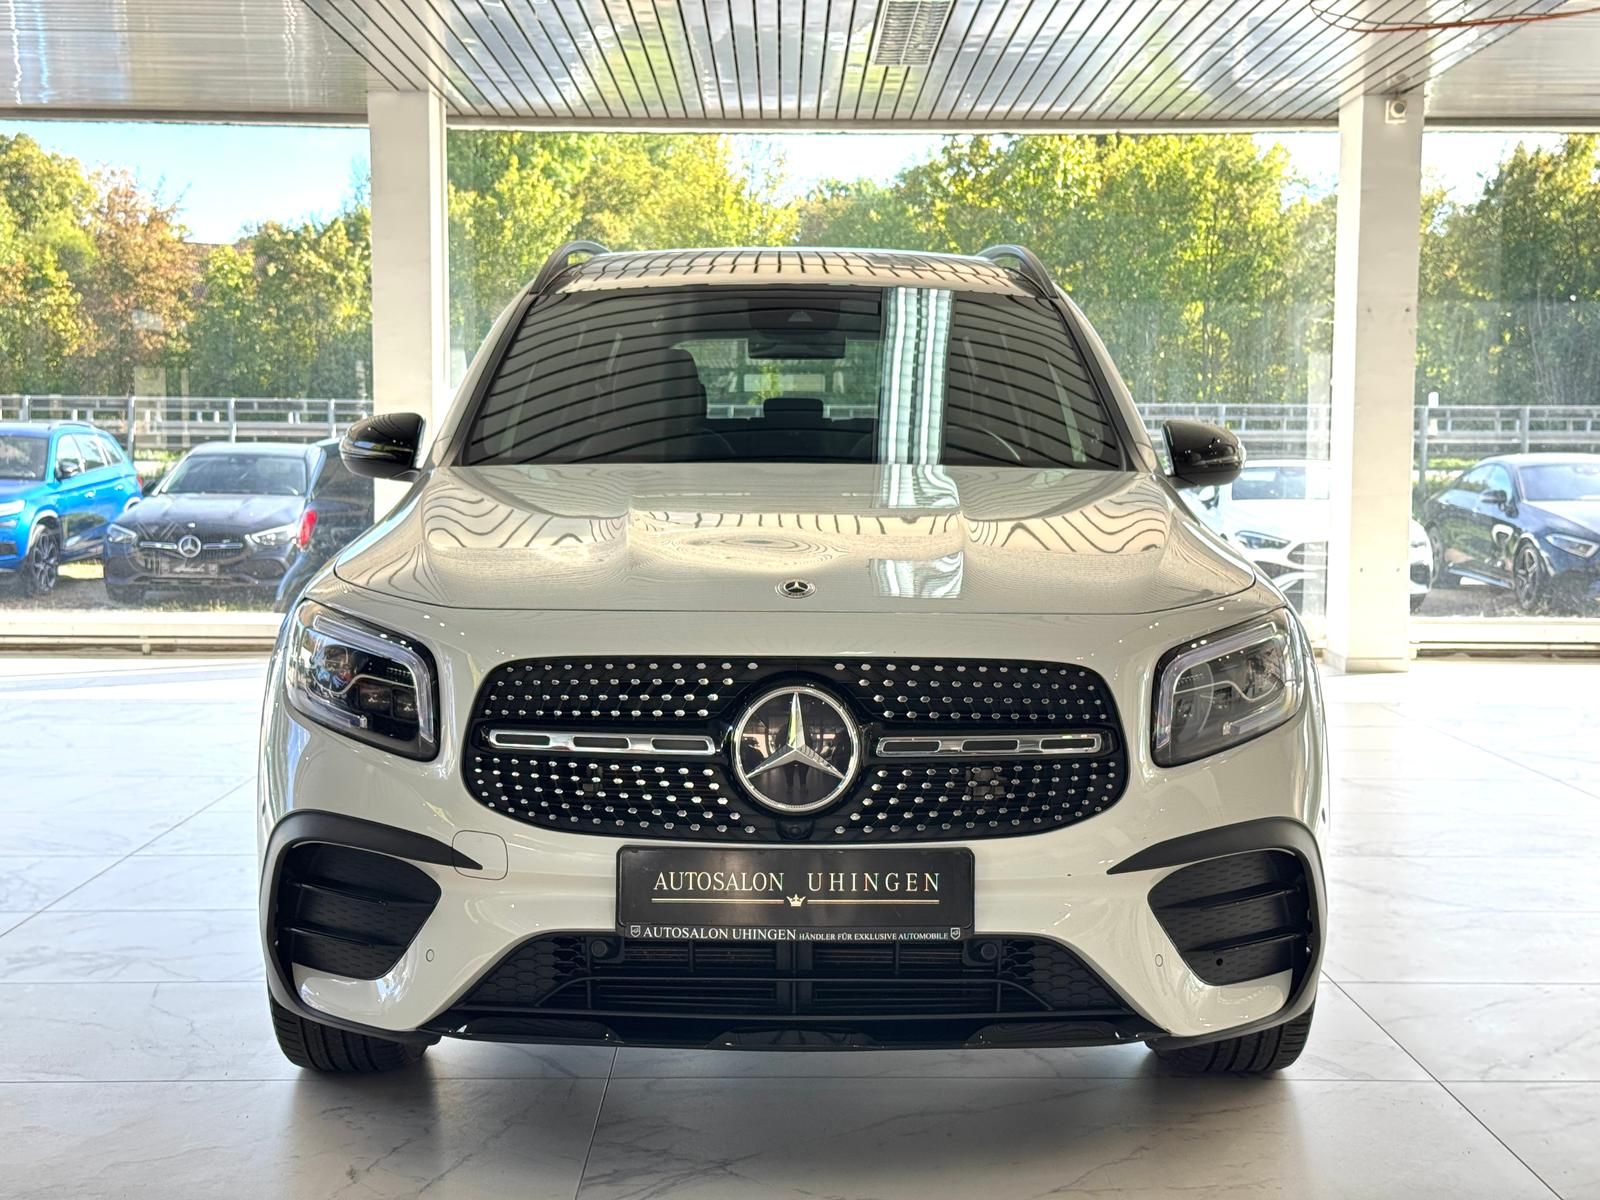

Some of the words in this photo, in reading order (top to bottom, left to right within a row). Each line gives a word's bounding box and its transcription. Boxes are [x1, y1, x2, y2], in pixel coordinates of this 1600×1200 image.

[653, 872, 785, 891] AUTOSALON
[808, 872, 940, 892] UHINGEN
[643, 926, 729, 940] AUTOSALON
[732, 928, 797, 941] UHINGEN
[799, 931, 836, 941] HÄNDLER
[837, 931, 853, 941] FÜR
[854, 932, 897, 941] EXKLUSIVE
[898, 932, 949, 941] AUTOMOBILE
